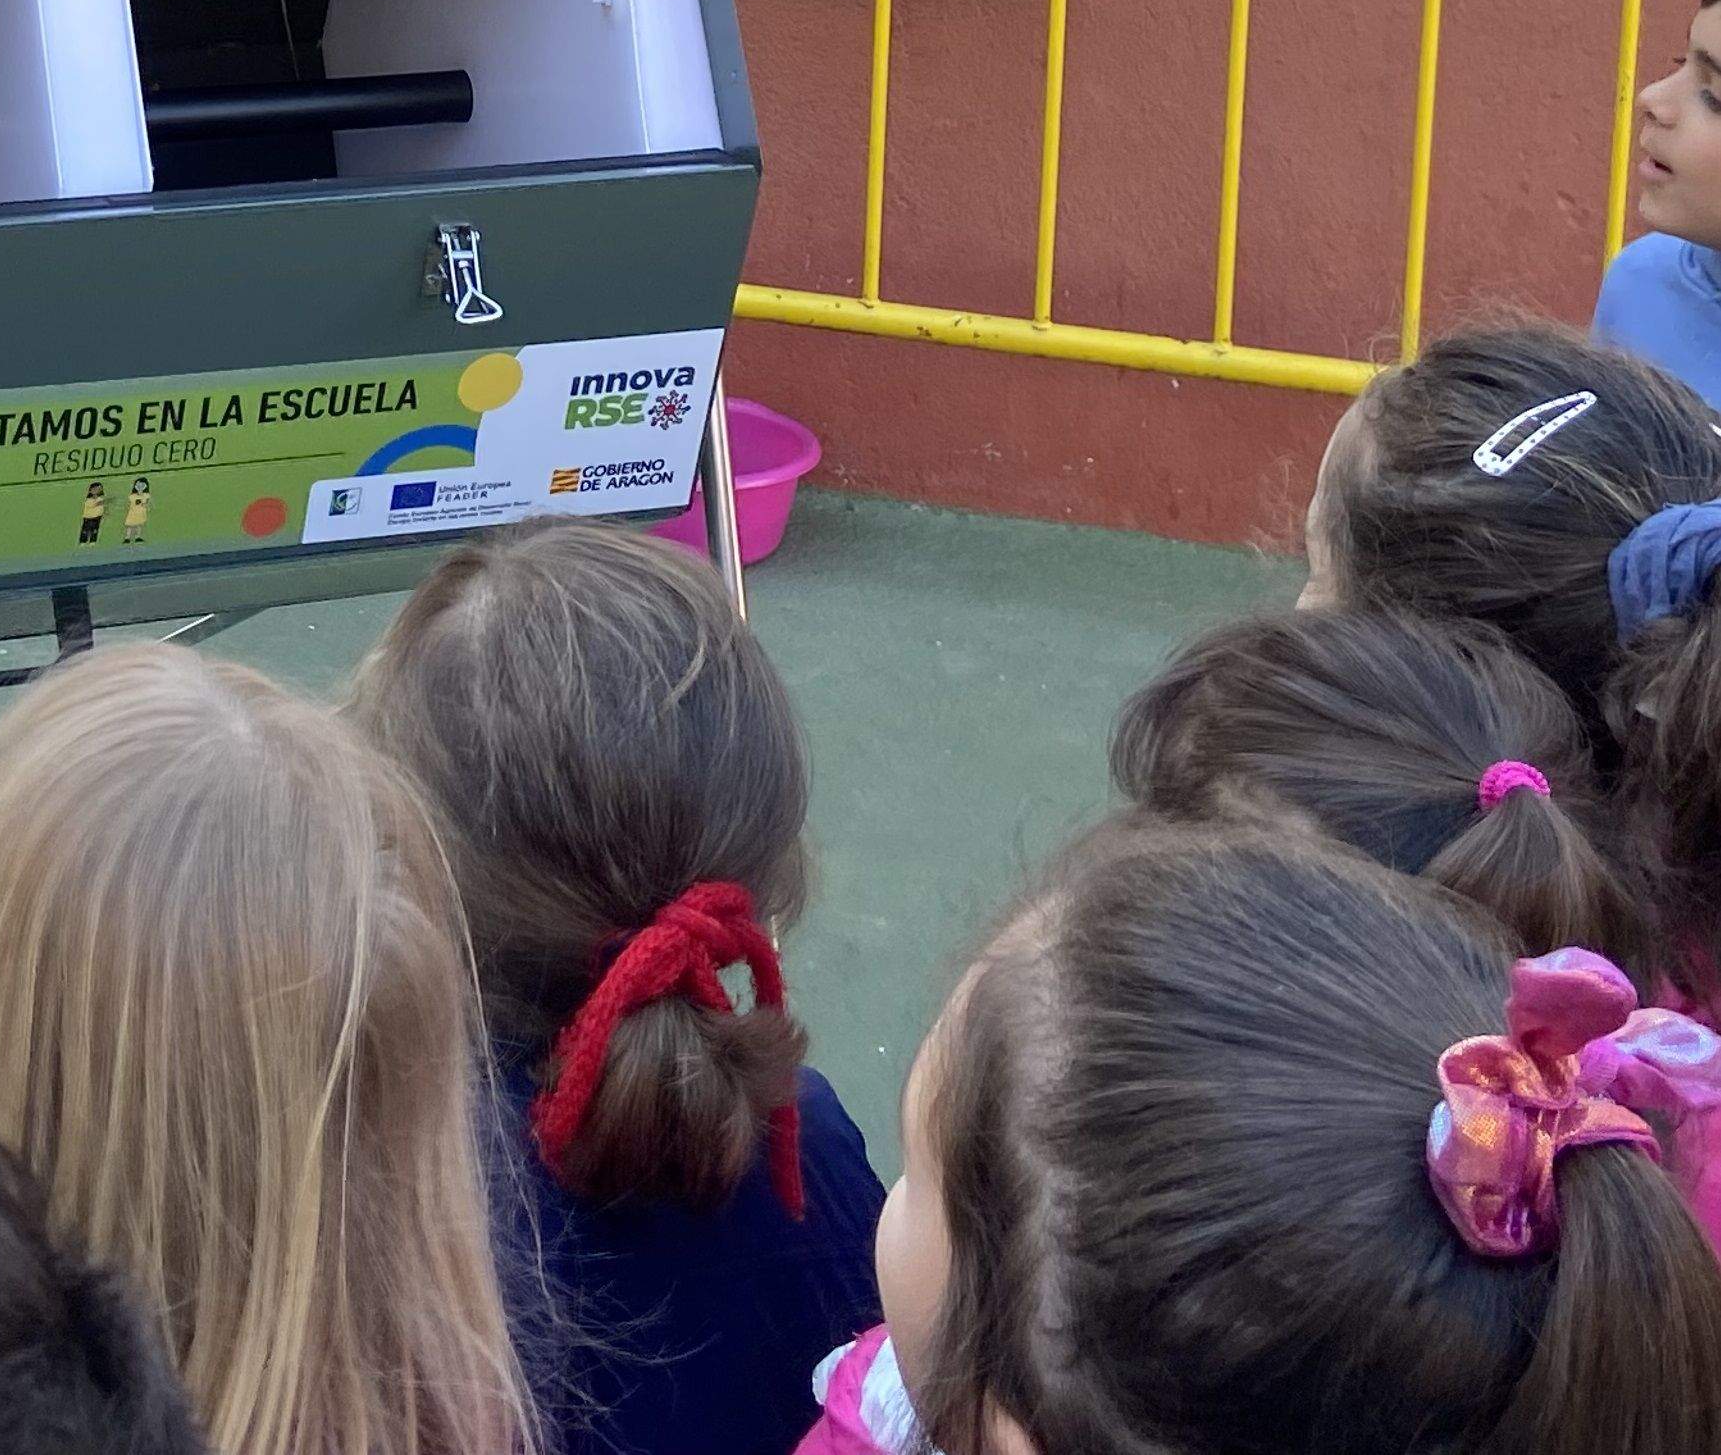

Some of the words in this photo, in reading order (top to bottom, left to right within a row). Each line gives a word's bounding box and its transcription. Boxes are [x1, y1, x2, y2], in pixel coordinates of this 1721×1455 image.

[137, 399, 186, 435] EN
[199, 394, 243, 429] LA
[258, 379, 418, 425] ESCUELA
[564, 393, 649, 430] RSE
[32, 443, 144, 476] RESIDUO
[152, 437, 217, 465] CERO
[582, 458, 666, 478] GOBIERNO
[580, 478, 602, 492] DE
